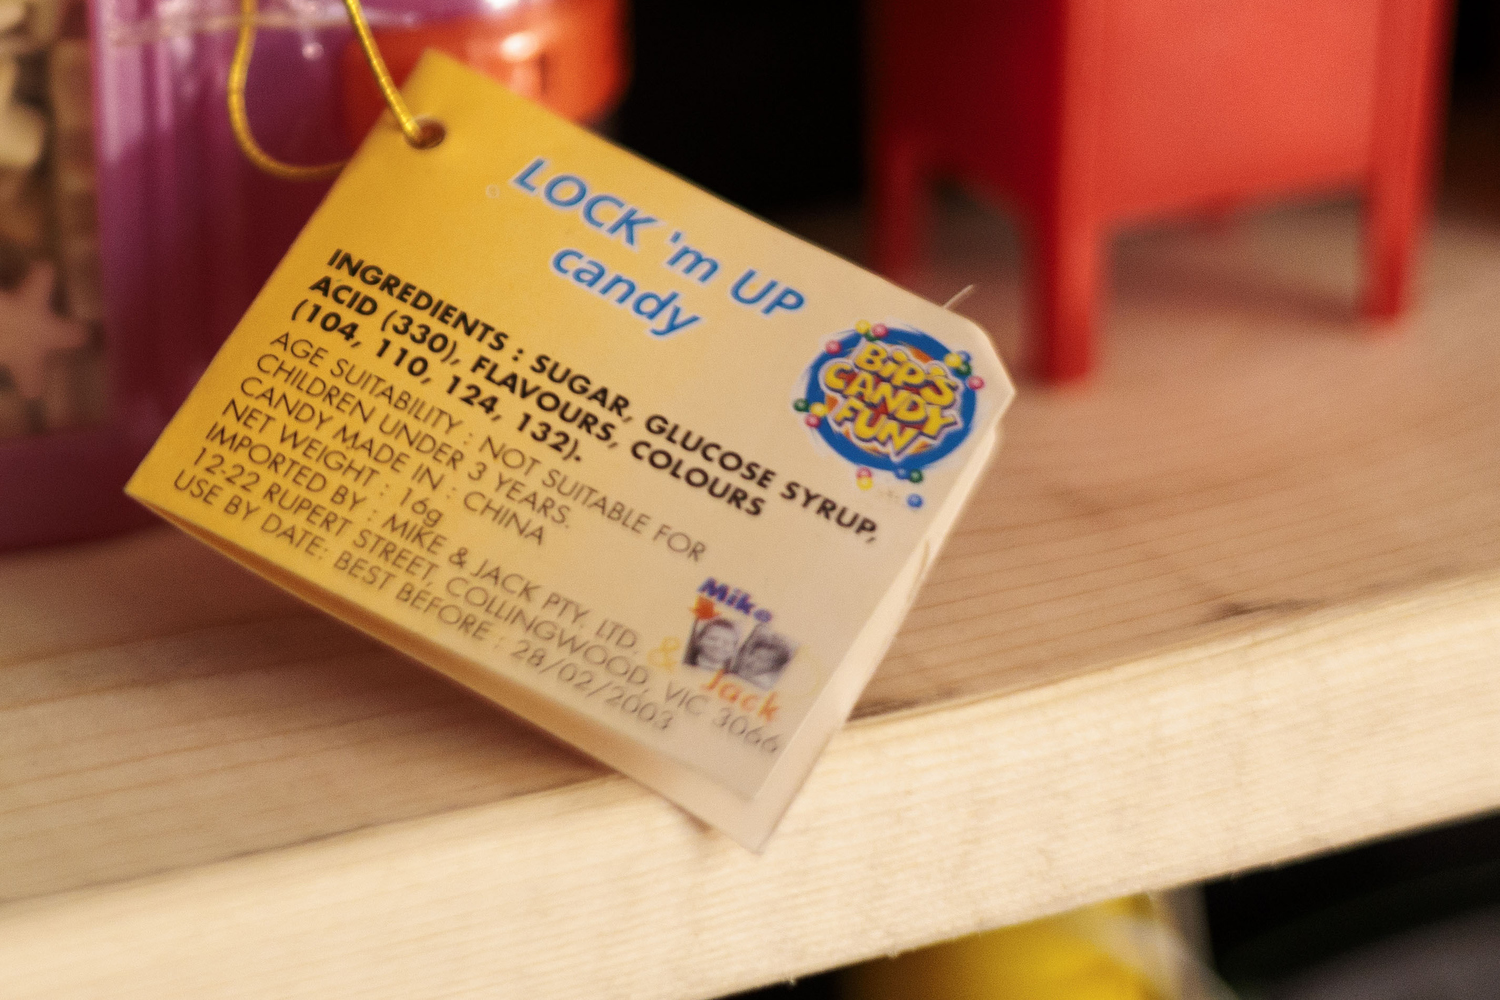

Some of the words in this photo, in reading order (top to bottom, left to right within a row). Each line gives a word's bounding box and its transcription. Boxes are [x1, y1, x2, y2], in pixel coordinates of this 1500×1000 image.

[512, 158, 658, 247] LOCK
[666, 230, 720, 283] 'm
[729, 268, 806, 315] UP
[551, 248, 701, 337] candy
[221, 397, 276, 434] NET
[279, 422, 381, 488] WEIGHT
[399, 486, 444, 529] 16g
[239, 376, 334, 431] CANDY
[331, 424, 412, 474] MADE
[410, 462, 445, 492] IN
[462, 490, 546, 547] CHINA
[256, 353, 376, 424] CHILDREN
[378, 412, 464, 471] UNDER
[466, 460, 488, 482] 3
[494, 471, 572, 530] YEARS.
[269, 331, 329, 368] AGE
[330, 357, 464, 435] SUITABILITY
[477, 434, 541, 477] NOT
[541, 468, 651, 535] SUITABLE
[652, 523, 707, 563] FOR
[290, 298, 362, 349] (104,
[375, 338, 432, 385] 110,
[445, 374, 502, 422] 124,
[516, 412, 583, 463] 132).
[308, 274, 379, 317] ACID
[381, 309, 461, 367] (330),
[470, 354, 619, 450] FLAVOURS,
[630, 439, 767, 517] COLOURS
[327, 248, 509, 352] INGREDIENTS
[529, 353, 634, 424] SUGAR,
[644, 413, 777, 490] GLUCOSE
[779, 480, 878, 544] SYRUP,
[824, 362, 958, 438] CANDY
[832, 397, 920, 453] FUN
[173, 468, 224, 506] USE
[223, 493, 261, 522] BY
[260, 512, 329, 561] DATE:
[332, 550, 397, 592] BEST
[396, 580, 495, 641] BEFORE
[510, 637, 677, 732] 28/02/2003
[193, 447, 261, 493] 12-22
[262, 481, 354, 538] RUPERT
[352, 527, 440, 588] STREET,
[445, 576, 652, 695] COLLINGWOOD,
[663, 679, 711, 717] VIC
[204, 421, 328, 494] IMPORTED
[330, 483, 367, 513] BY
[381, 512, 448, 556] MIKE
[448, 545, 469, 570] &
[470, 557, 542, 603] JACK
[541, 591, 592, 629] PTY.
[595, 618, 640, 655] LTD.
[697, 576, 774, 624] Mike
[702, 668, 780, 723] Jack
